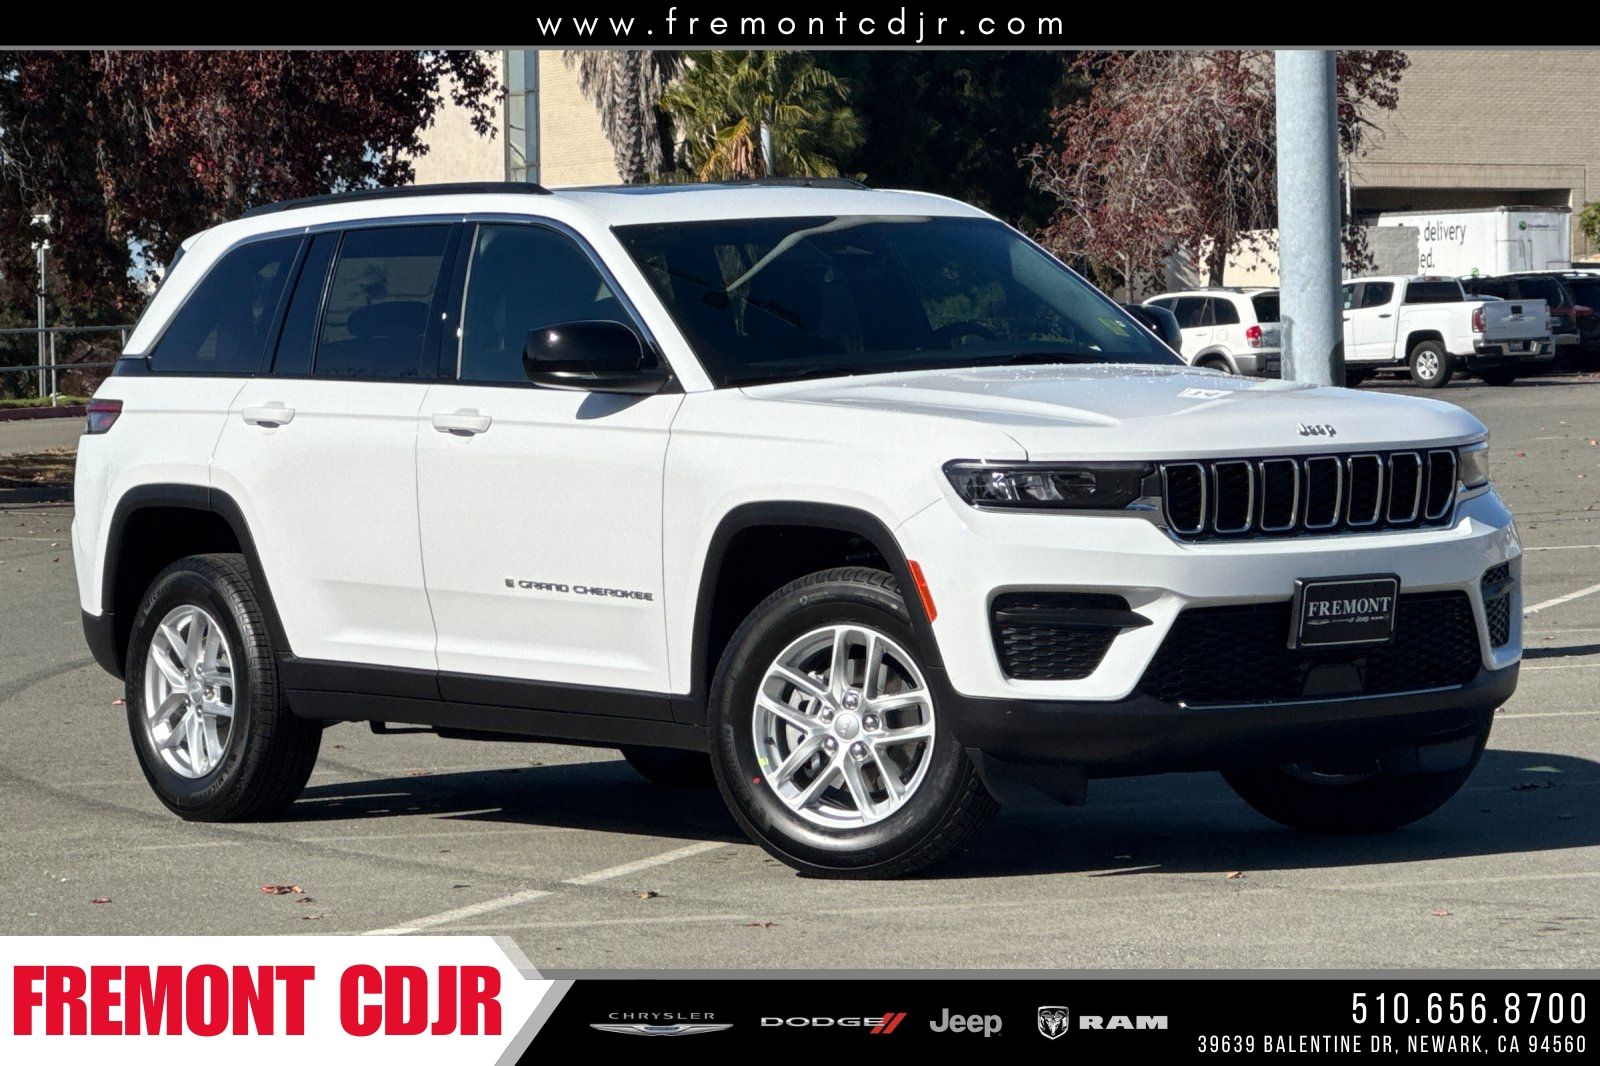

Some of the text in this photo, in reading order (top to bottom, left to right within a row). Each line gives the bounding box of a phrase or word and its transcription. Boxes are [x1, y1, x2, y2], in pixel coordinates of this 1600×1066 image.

[1424, 220, 1466, 245] delivery
[1297, 422, 1337, 437] Jeep
[518, 580, 653, 601] GRAND CHEROKEE
[1307, 597, 1392, 617] FREMONT
